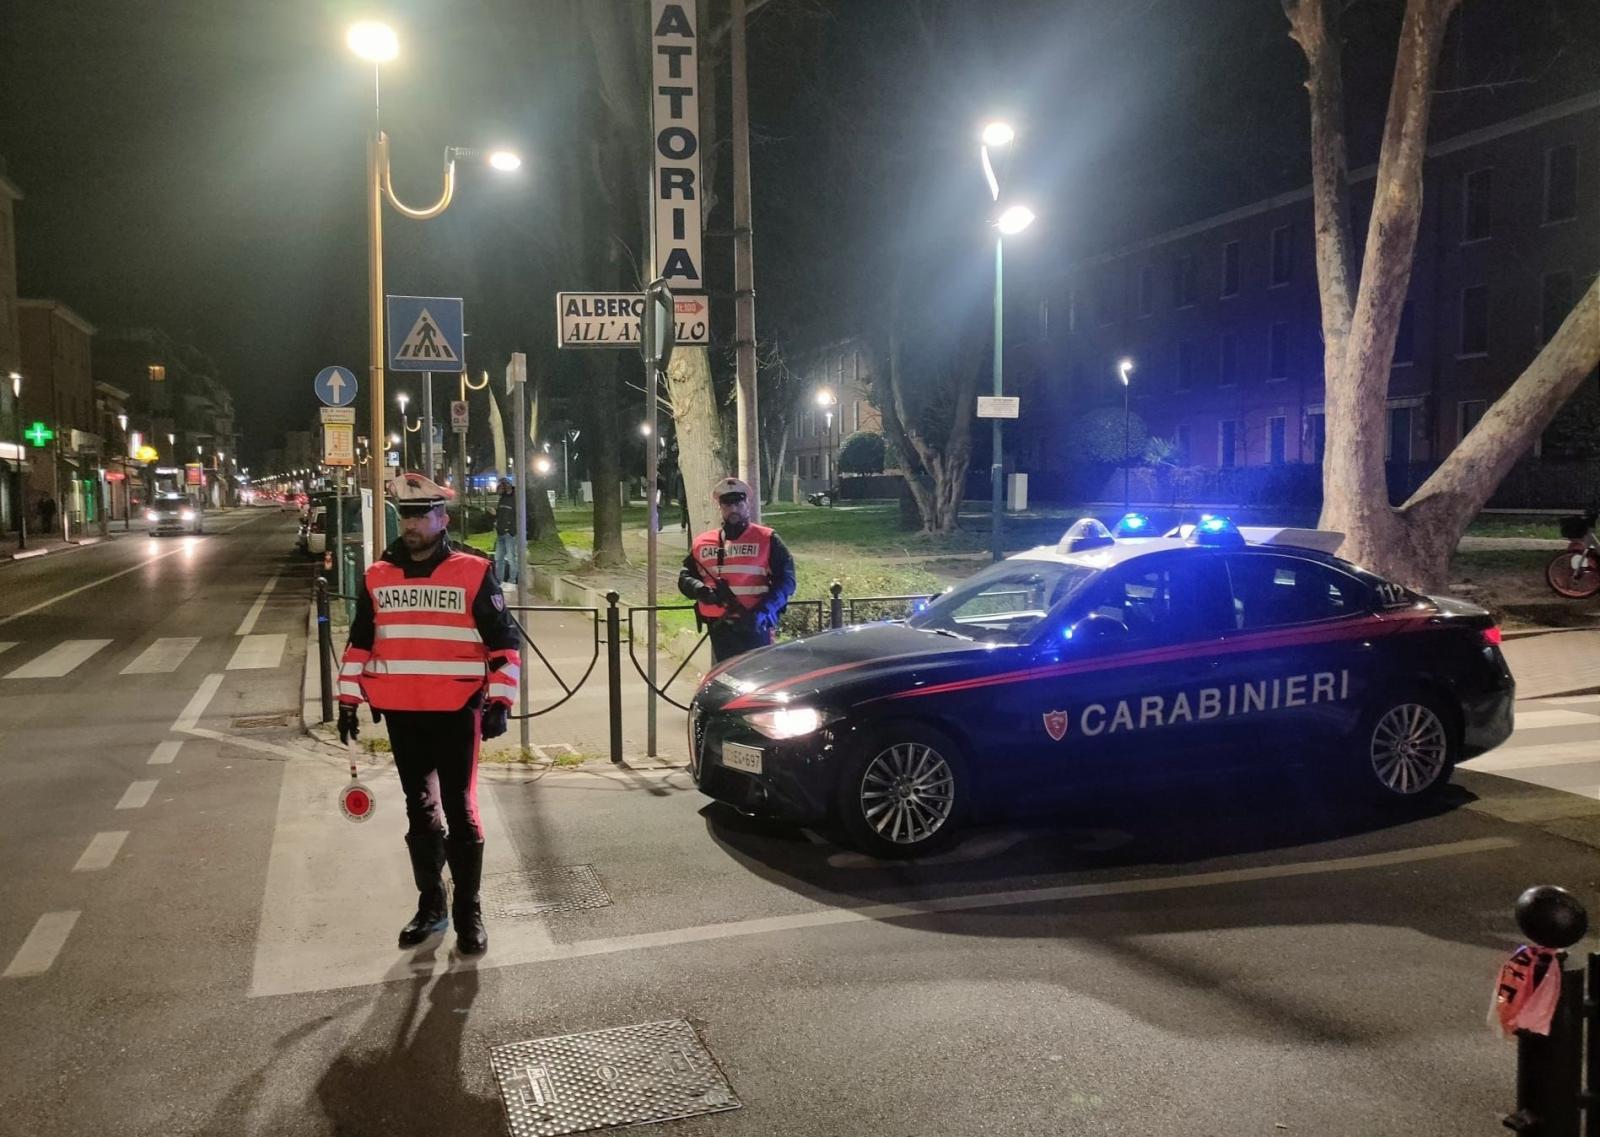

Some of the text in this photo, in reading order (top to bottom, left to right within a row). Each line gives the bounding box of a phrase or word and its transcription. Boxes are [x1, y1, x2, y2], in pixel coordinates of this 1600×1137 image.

[654, 4, 700, 281] ATTORIA
[378, 588, 462, 610] CARABINIERI
[1080, 669, 1349, 737] CARABINIERI
